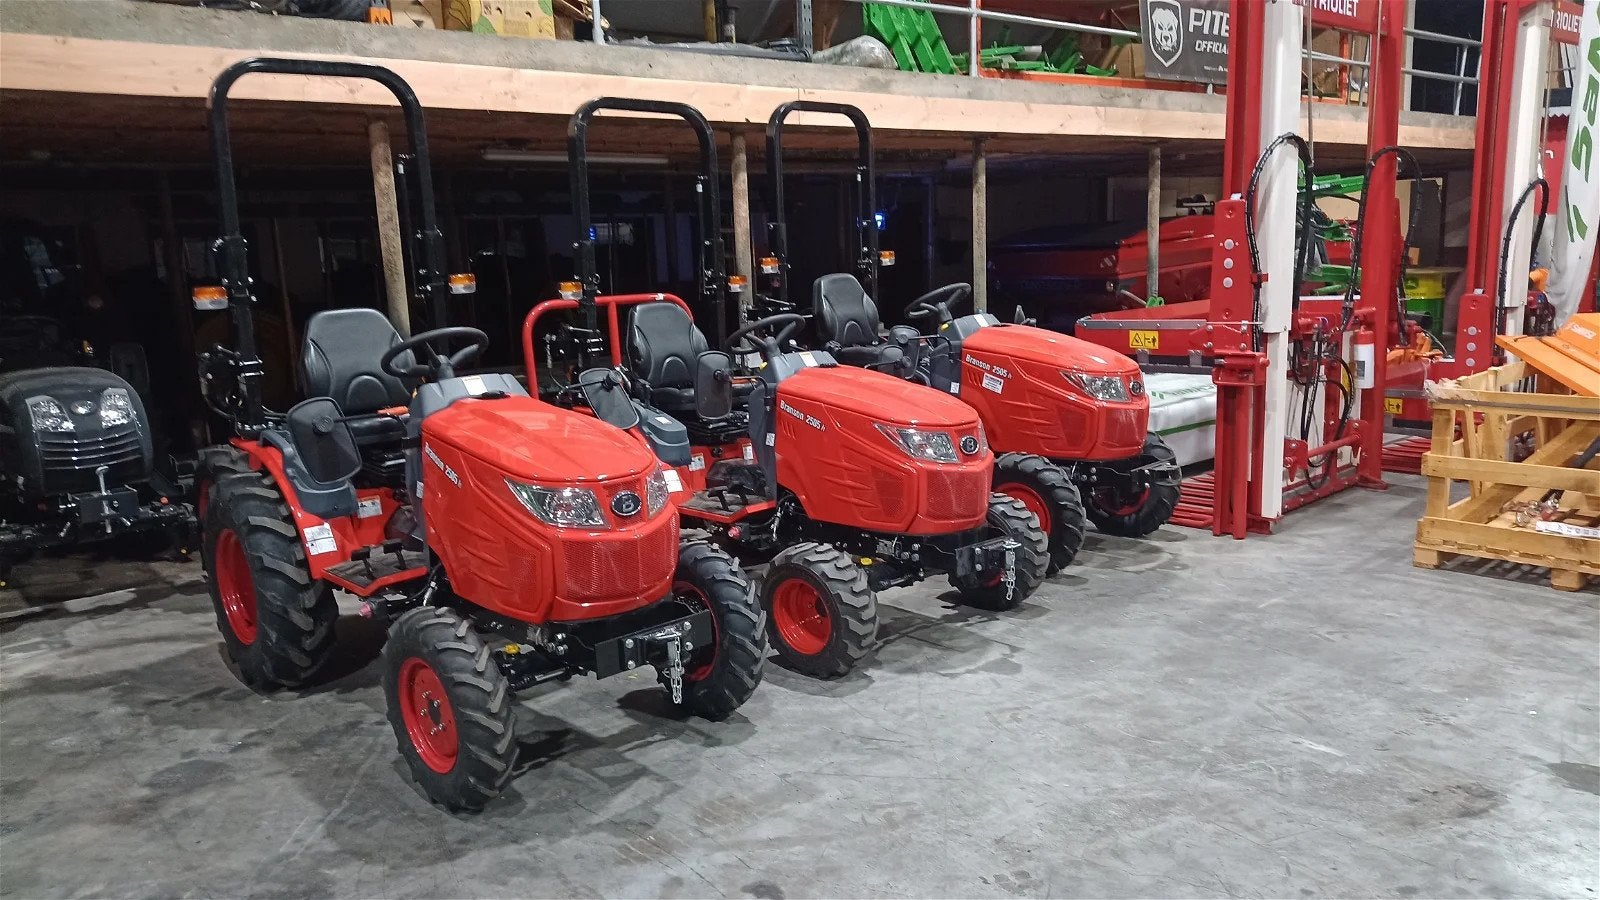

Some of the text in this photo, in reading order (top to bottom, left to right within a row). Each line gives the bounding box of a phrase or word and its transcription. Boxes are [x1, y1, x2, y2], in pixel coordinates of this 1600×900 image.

[965, 353, 990, 371] Branson
[992, 365, 1008, 378] 2505
[780, 399, 804, 421] Branson
[805, 414, 821, 430] 2505
